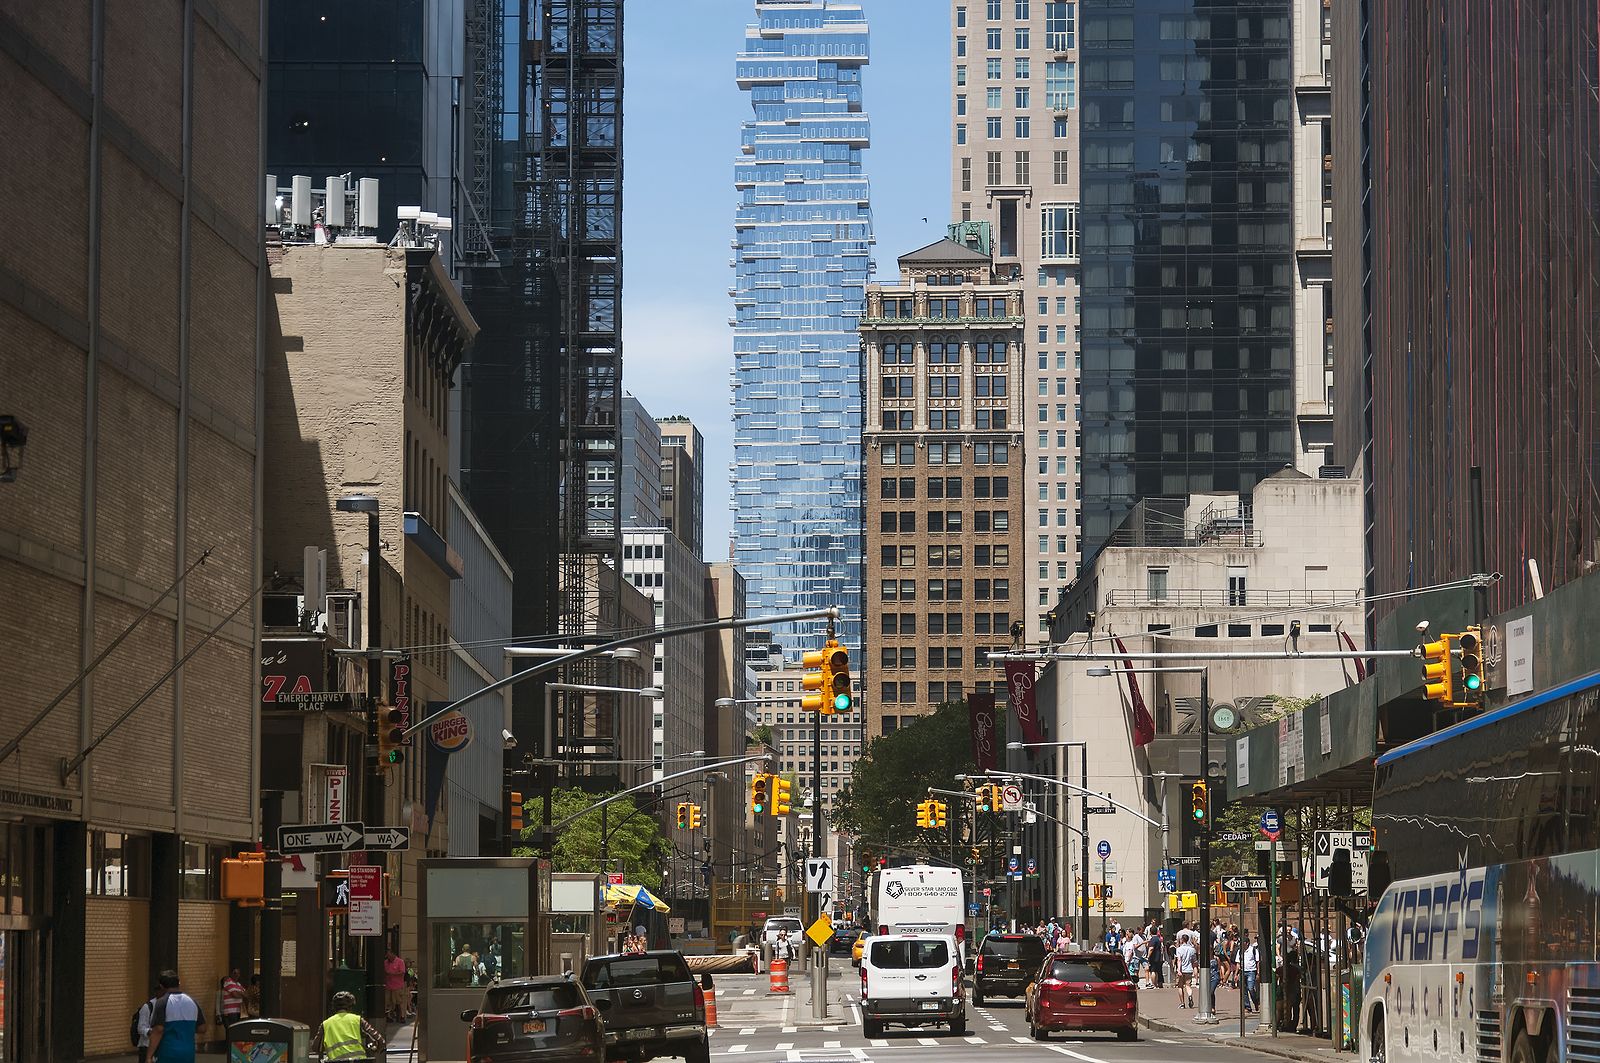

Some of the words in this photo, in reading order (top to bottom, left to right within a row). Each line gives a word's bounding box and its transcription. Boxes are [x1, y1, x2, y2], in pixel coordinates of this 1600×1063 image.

[261, 675, 312, 702] ZA
[278, 694, 309, 702] EMERIC
[311, 693, 344, 702] HARVEY
[298, 702, 325, 710] PLACE
[432, 716, 466, 733] BURGER
[434, 724, 468, 743] KING
[329, 778, 342, 824] PIZZ
[286, 834, 312, 846] ONE
[325, 832, 352, 843] WAY
[377, 834, 400, 843] WAY
[1333, 838, 1352, 846] BUS
[1385, 984, 1474, 1018] COACHES
